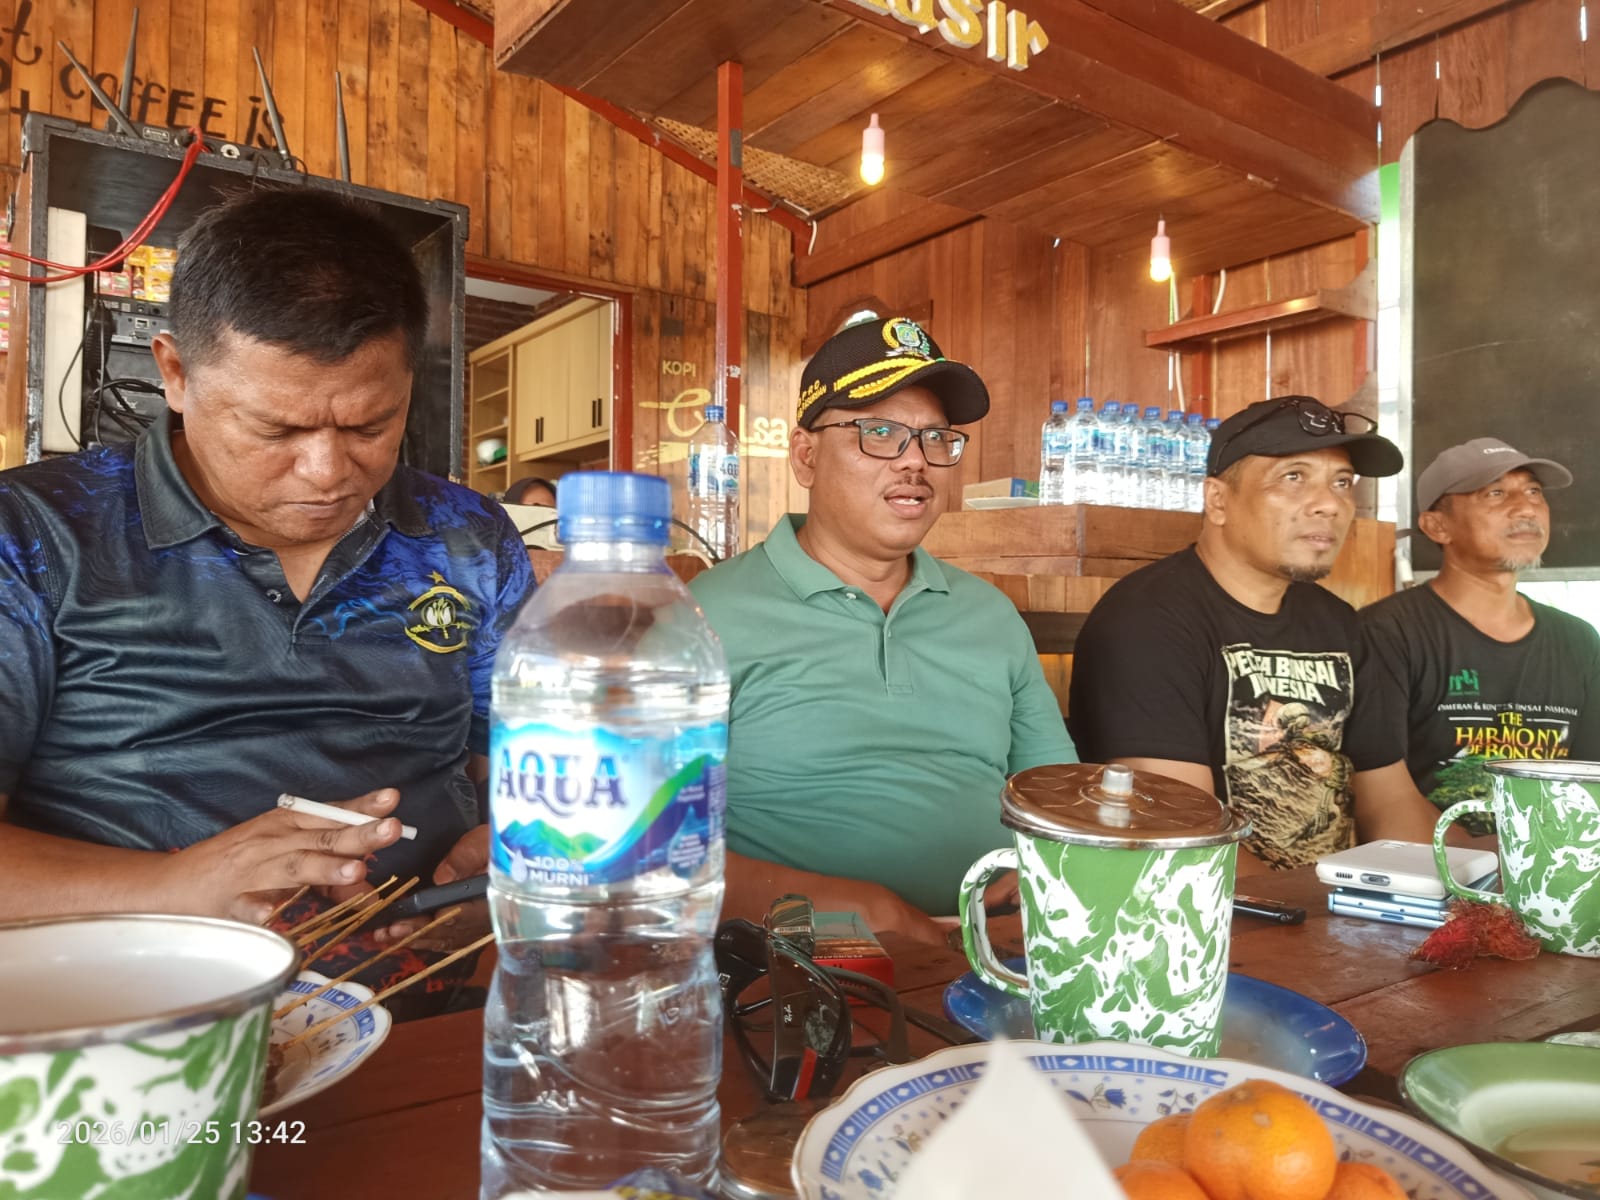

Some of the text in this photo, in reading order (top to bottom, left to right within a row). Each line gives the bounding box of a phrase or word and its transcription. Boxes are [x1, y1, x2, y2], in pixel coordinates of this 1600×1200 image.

[662, 360, 697, 377] KOPI
[1497, 712, 1523, 726] THE
[1455, 726, 1561, 747] HARMONY
[497, 748, 627, 818] AQUA
[530, 870, 589, 886] MURNI
